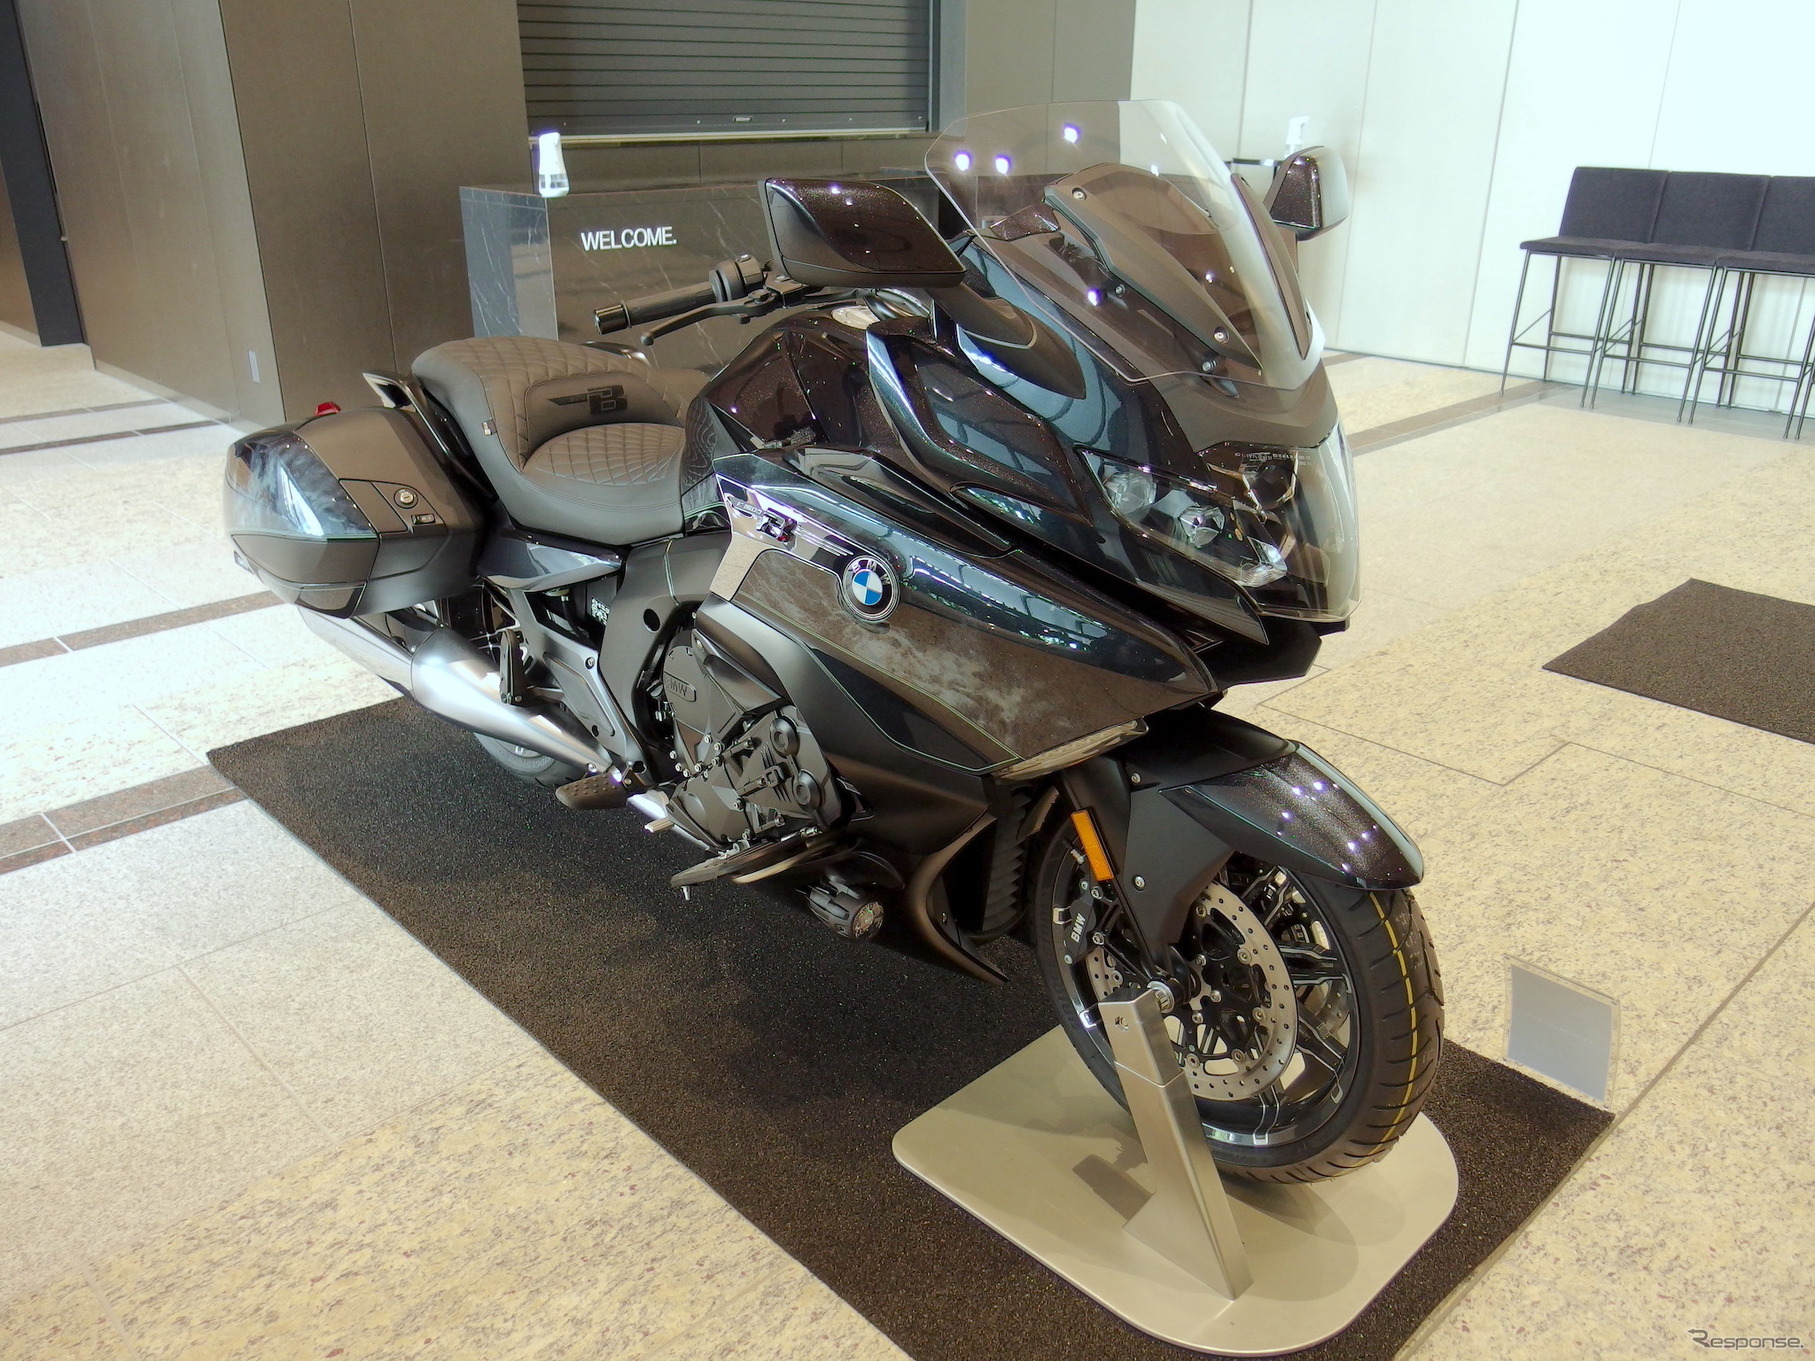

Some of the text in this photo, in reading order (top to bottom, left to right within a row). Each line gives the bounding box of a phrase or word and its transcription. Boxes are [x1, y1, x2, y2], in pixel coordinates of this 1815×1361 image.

[580, 226, 678, 251] WELCOME.
[851, 560, 891, 586] BMW
[1070, 912, 1086, 943] BMW
